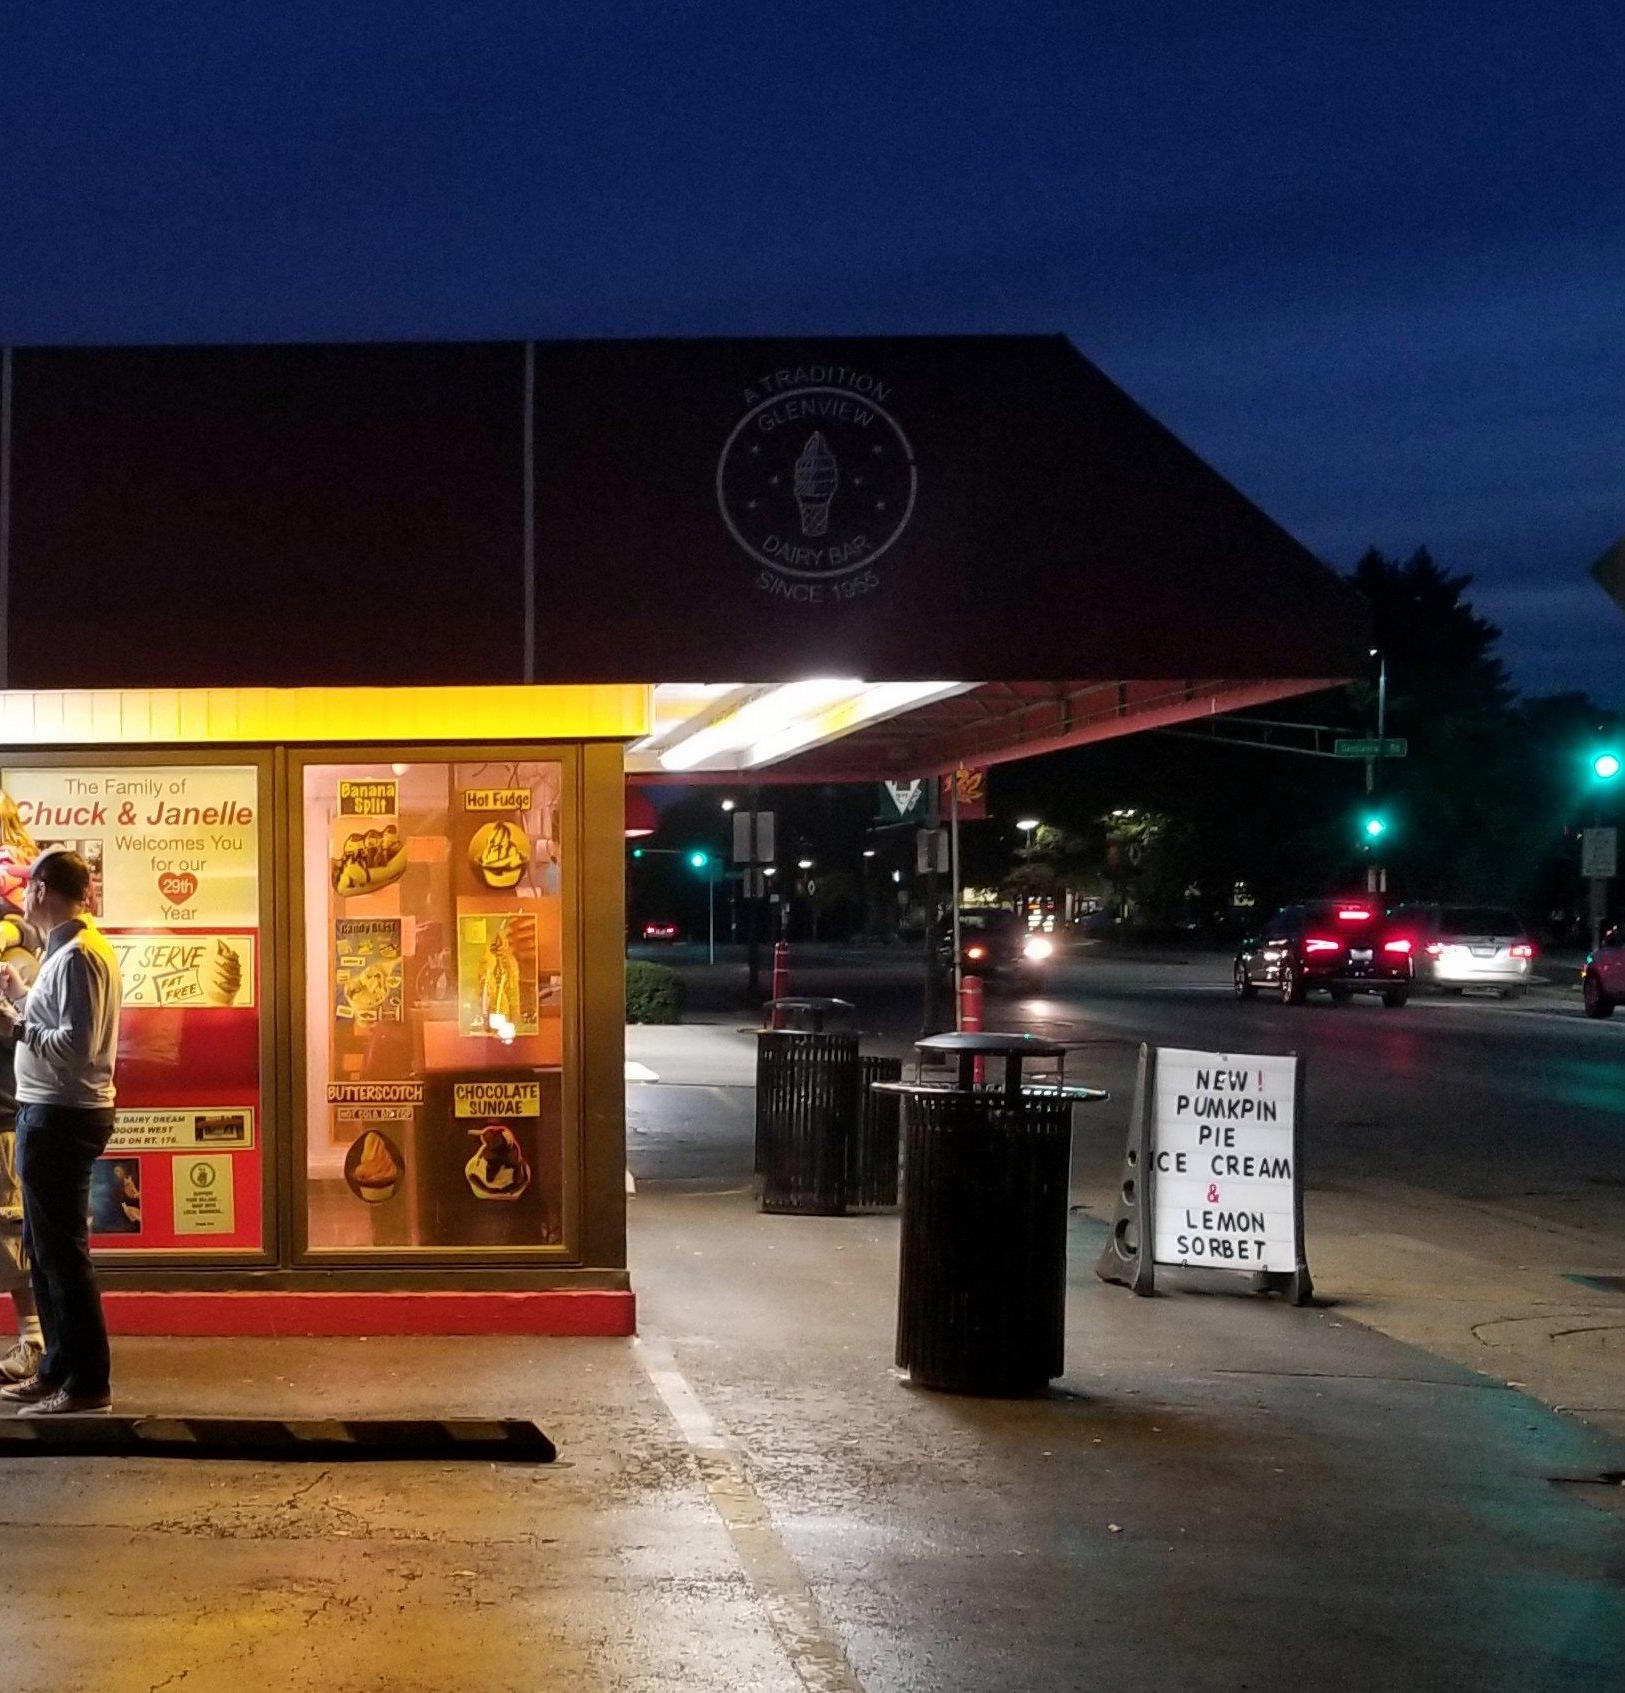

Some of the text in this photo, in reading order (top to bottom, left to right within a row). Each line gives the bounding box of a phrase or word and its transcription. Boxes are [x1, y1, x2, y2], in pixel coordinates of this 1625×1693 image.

[743, 366, 892, 404] A TRADITION
[758, 400, 874, 432] GLENVIEW
[762, 535, 871, 566] DAIRY BAR
[758, 571, 879, 601] SINCE 1955
[66, 778, 187, 799] The Family of
[341, 783, 396, 798] Banana
[354, 797, 388, 816] Split
[467, 792, 530, 811] Hot Fudge
[18, 801, 253, 826] Chuck & Janelle
[115, 835, 243, 851] Welcomes You
[151, 856, 207, 871] for our
[163, 878, 194, 894] 29th
[160, 905, 198, 921] Year
[138, 945, 207, 971] SERVE
[162, 975, 185, 989] FAT
[166, 984, 198, 1001] FREE
[327, 1085, 424, 1101] BUTTERSCOTCH
[456, 1084, 538, 1100] CHOCOLATE
[469, 1100, 524, 1116] SUNDAE
[1177, 1095, 1277, 1121] PUMKPIN
[123, 1116, 151, 1124] DAIRY
[153, 1115, 186, 1123] DREAM
[147, 1126, 174, 1134] WEST
[1198, 1125, 1236, 1148] PIE
[1211, 1155, 1292, 1180] CREAM
[1206, 1183, 1220, 1204] &
[1186, 1209, 1266, 1233] LEMON
[1177, 1236, 1267, 1261] SORBET
